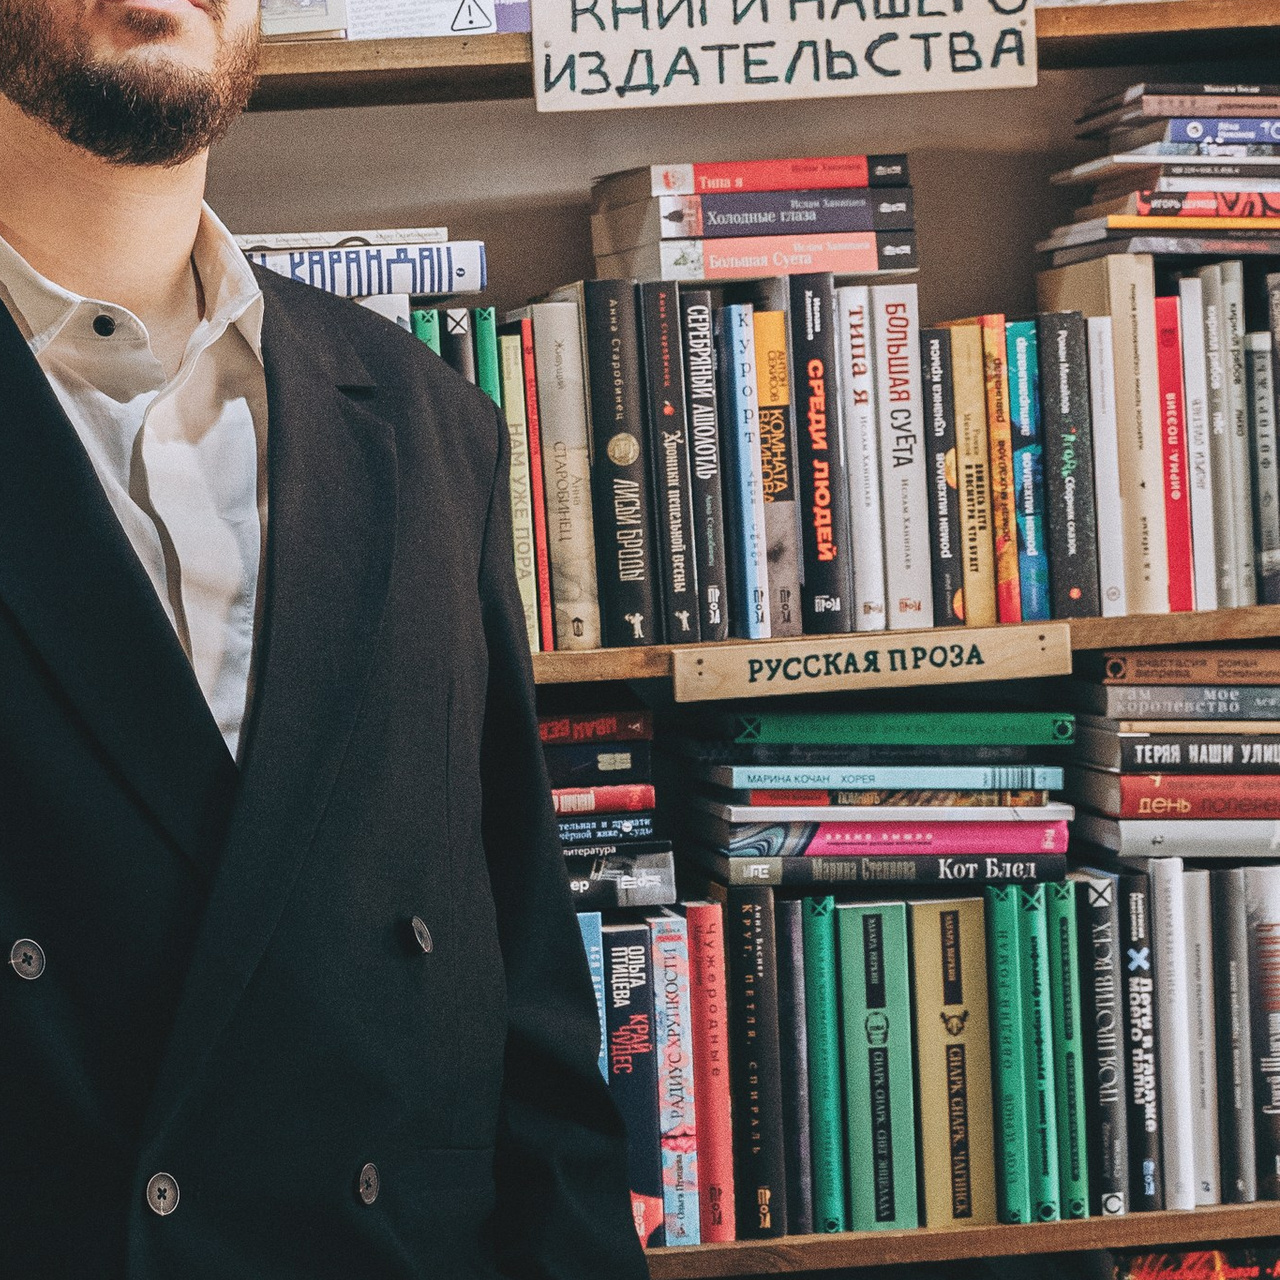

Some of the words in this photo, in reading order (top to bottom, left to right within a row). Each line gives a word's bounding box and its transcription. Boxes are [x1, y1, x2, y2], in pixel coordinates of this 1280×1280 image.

[543, 30, 1026, 98] ИЗДАТЕЛЬСТВА
[886, 302, 911, 403] БОЛЬШАЯ
[807, 358, 827, 450] СРЕДИ
[813, 459, 837, 561] ЛЮДЕЙ
[747, 649, 880, 683] РУССКАЯ
[889, 643, 985, 672] ПРОЗА
[1188, 744, 1234, 764] НАШИ
[937, 858, 978, 880] Кот
[984, 857, 1037, 880] Блед
